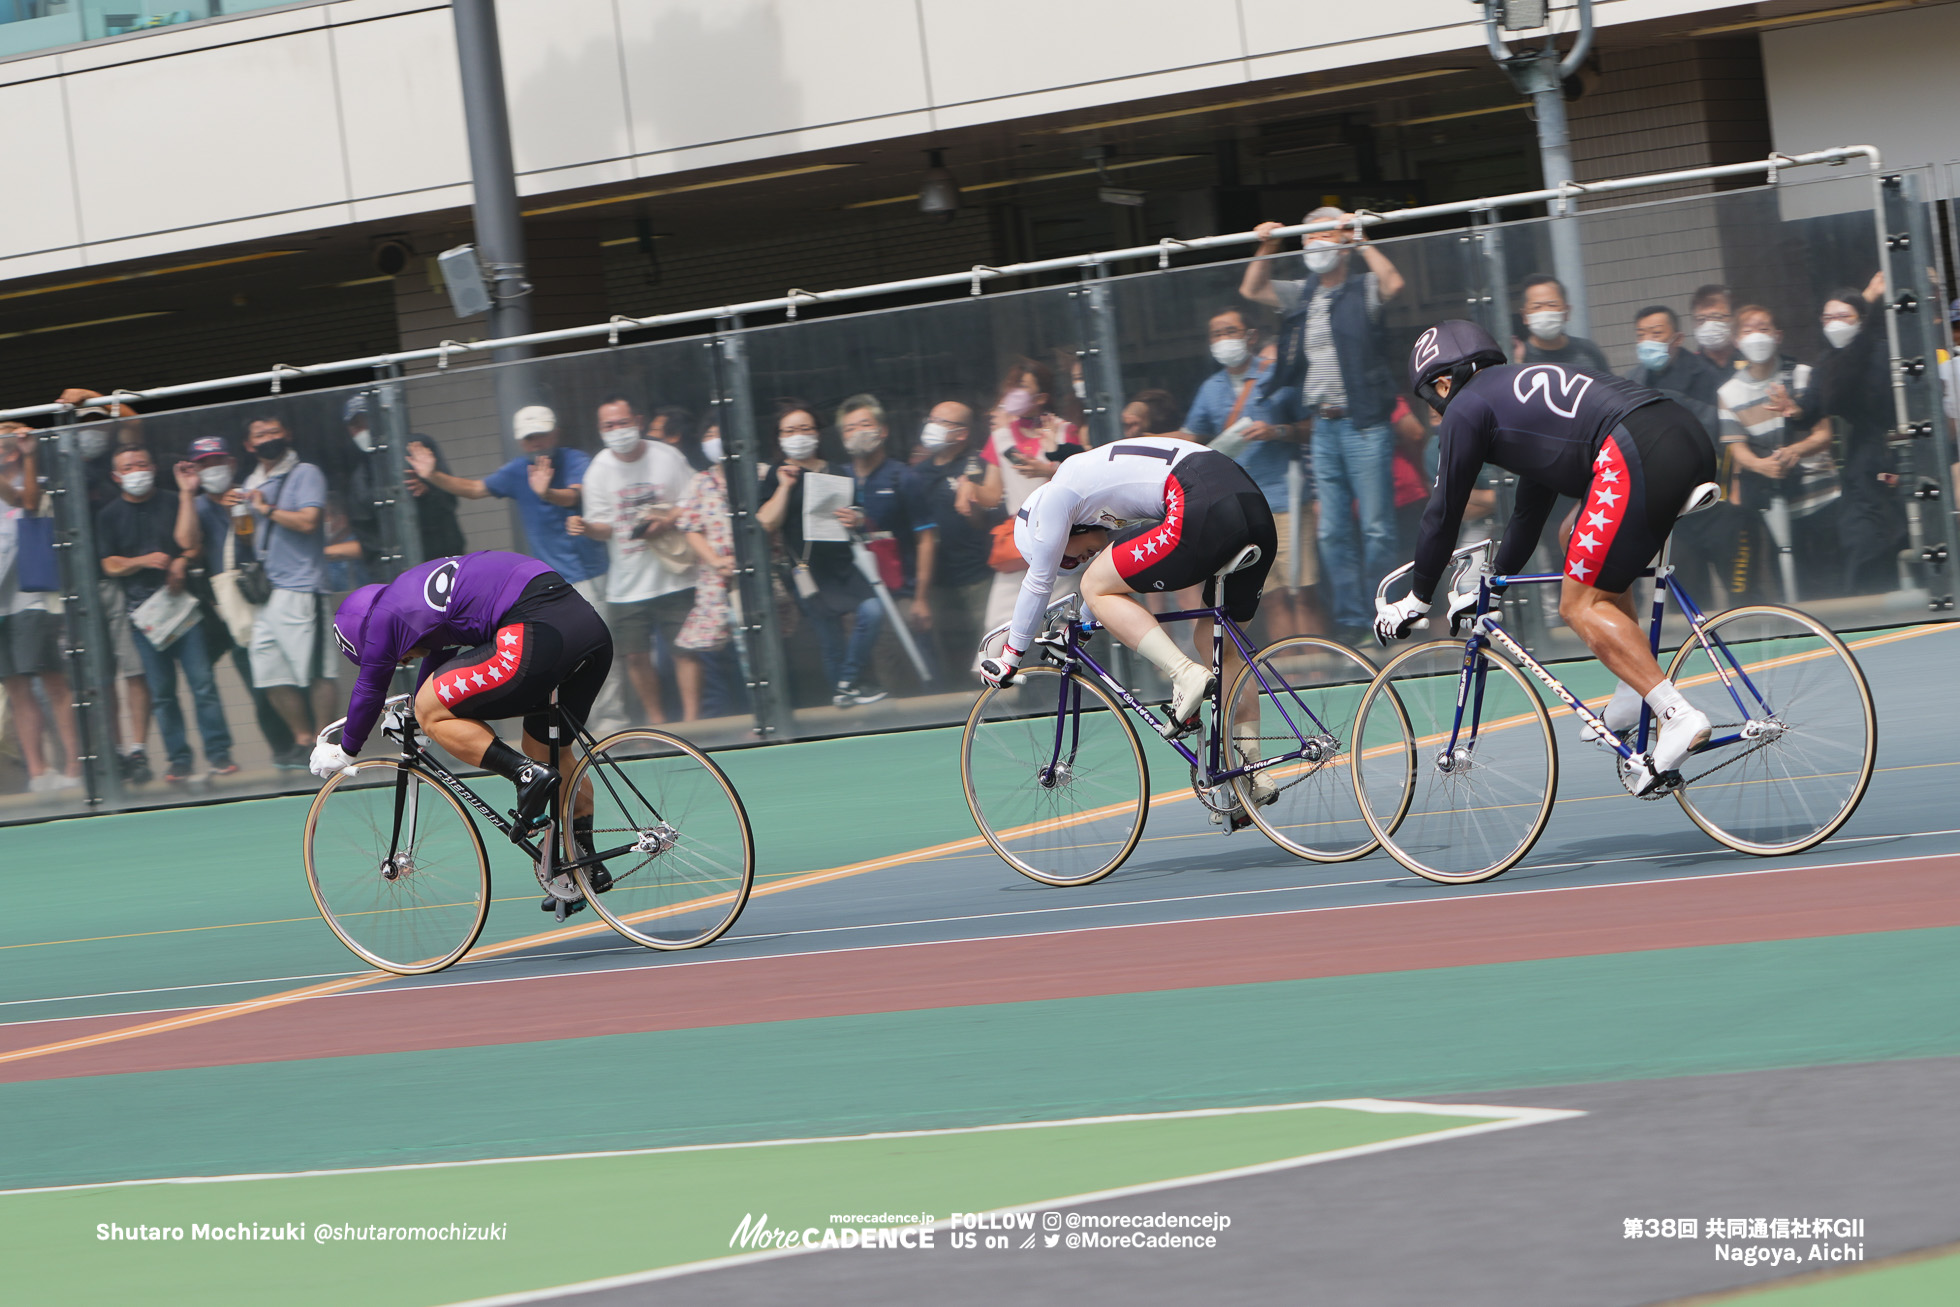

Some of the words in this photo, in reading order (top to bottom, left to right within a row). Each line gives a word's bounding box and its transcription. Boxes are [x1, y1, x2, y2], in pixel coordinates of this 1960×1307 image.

[1414, 326, 1440, 373] 2
[1513, 364, 1594, 418] 2
[1108, 445, 1180, 466] 1
